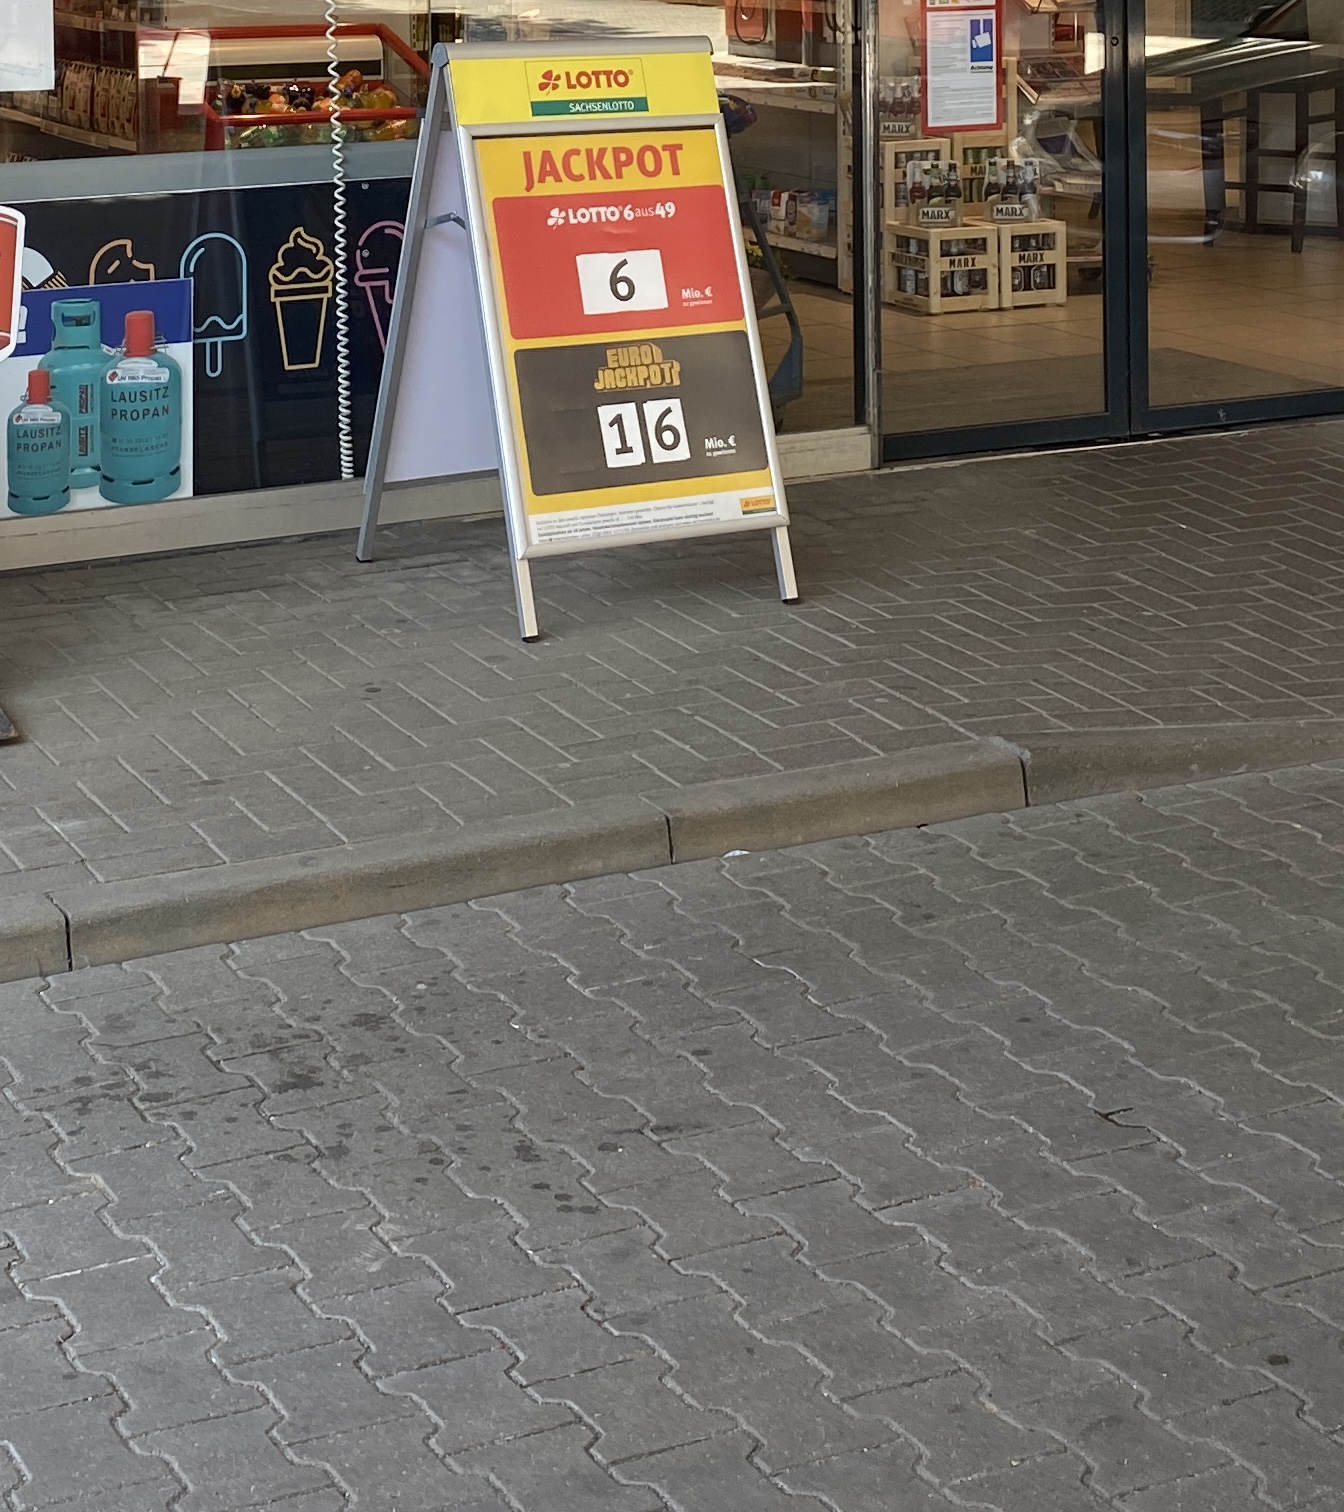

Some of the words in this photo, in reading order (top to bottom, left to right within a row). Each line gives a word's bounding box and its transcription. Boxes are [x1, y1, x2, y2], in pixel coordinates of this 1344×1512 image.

[569, 100, 634, 113] SACHSENLOTTO
[882, 124, 911, 135] MARX
[523, 143, 683, 193] JACKPOT
[922, 208, 951, 220] MARX
[996, 206, 1025, 217] MARX
[949, 257, 976, 269] MARX
[1019, 251, 1045, 264] MARX
[609, 258, 636, 302] 6
[682, 288, 704, 299] Mio.
[606, 345, 653, 368] EURO
[594, 362, 675, 390] JACKPOT
[111, 386, 170, 403] LAUSITZ
[111, 404, 170, 422] PROPAN
[16, 425, 62, 439] LAUSITZ
[16, 439, 62, 453] PROPAN
[705, 437, 727, 449] Mio.
[728, 435, 736, 447] €
